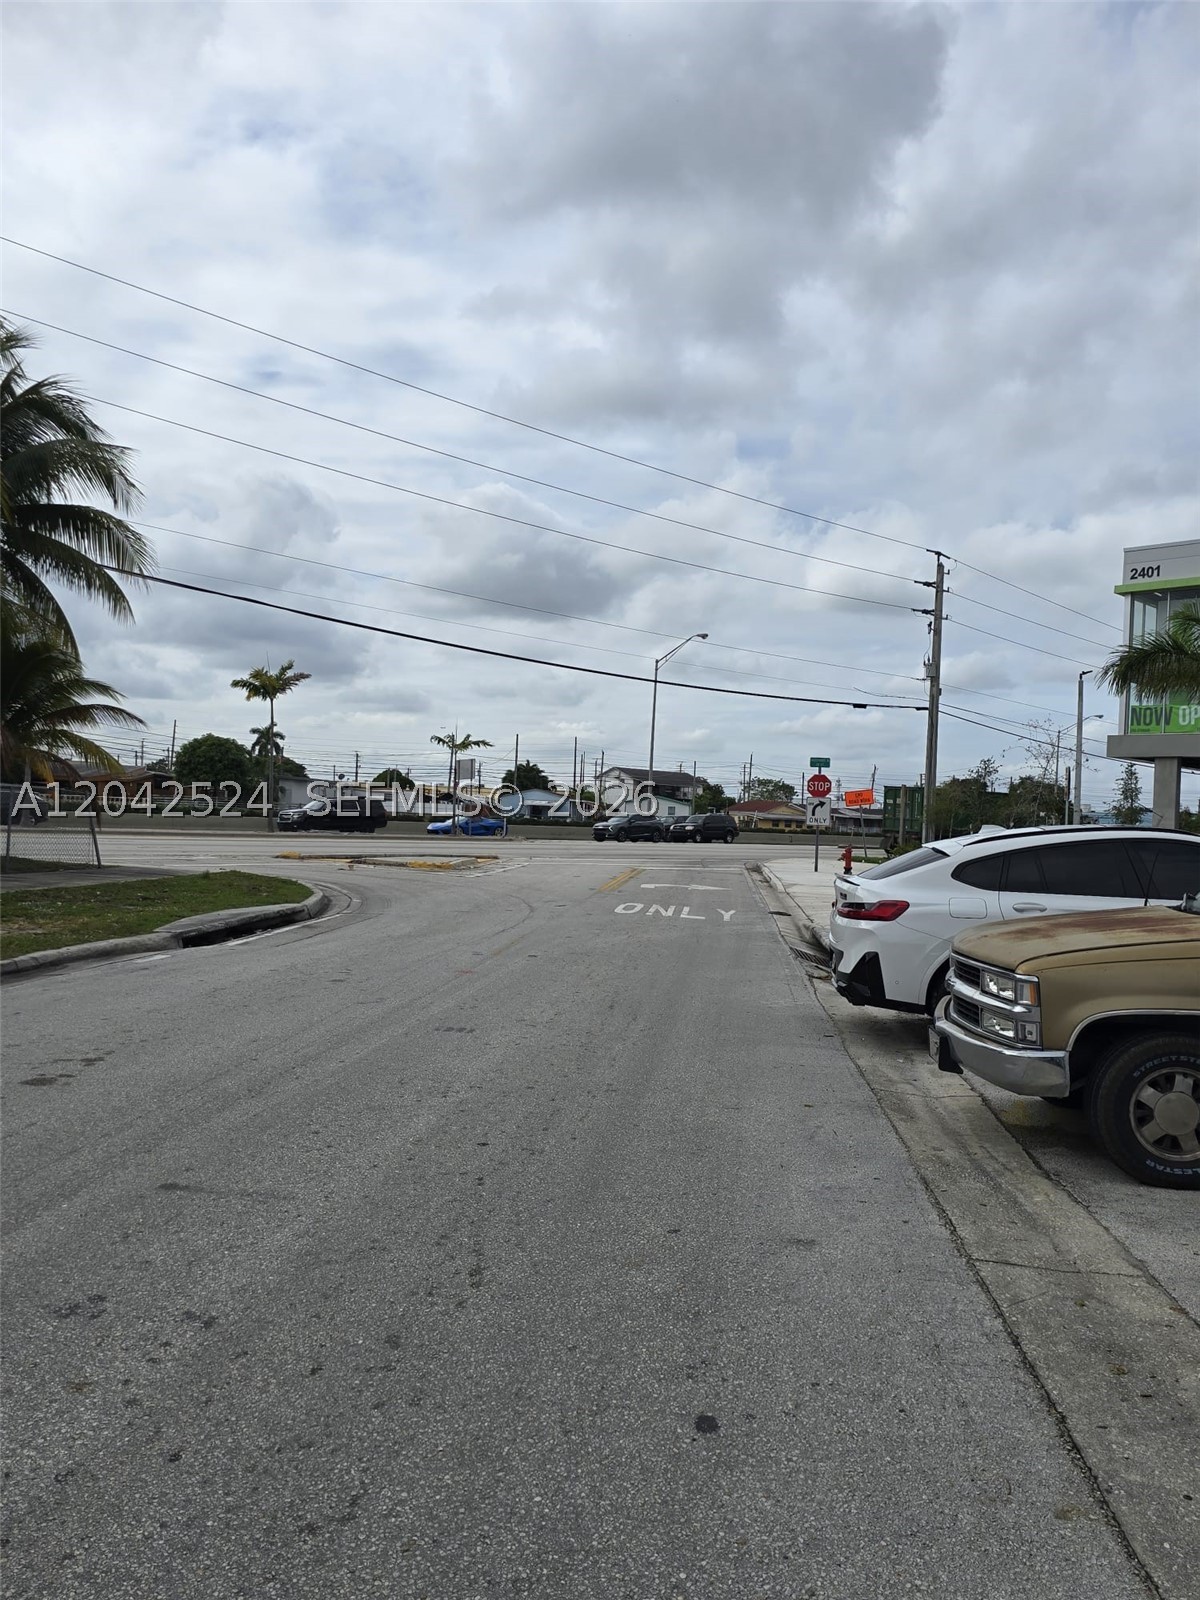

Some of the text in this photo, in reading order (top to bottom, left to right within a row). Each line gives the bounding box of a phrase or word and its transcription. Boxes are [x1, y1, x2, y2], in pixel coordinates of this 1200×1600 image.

[1129, 565, 1161, 580] 2401
[1130, 705, 1200, 727] NOW OP
[808, 781, 831, 792] STOP
[614, 902, 736, 921] ONLY
